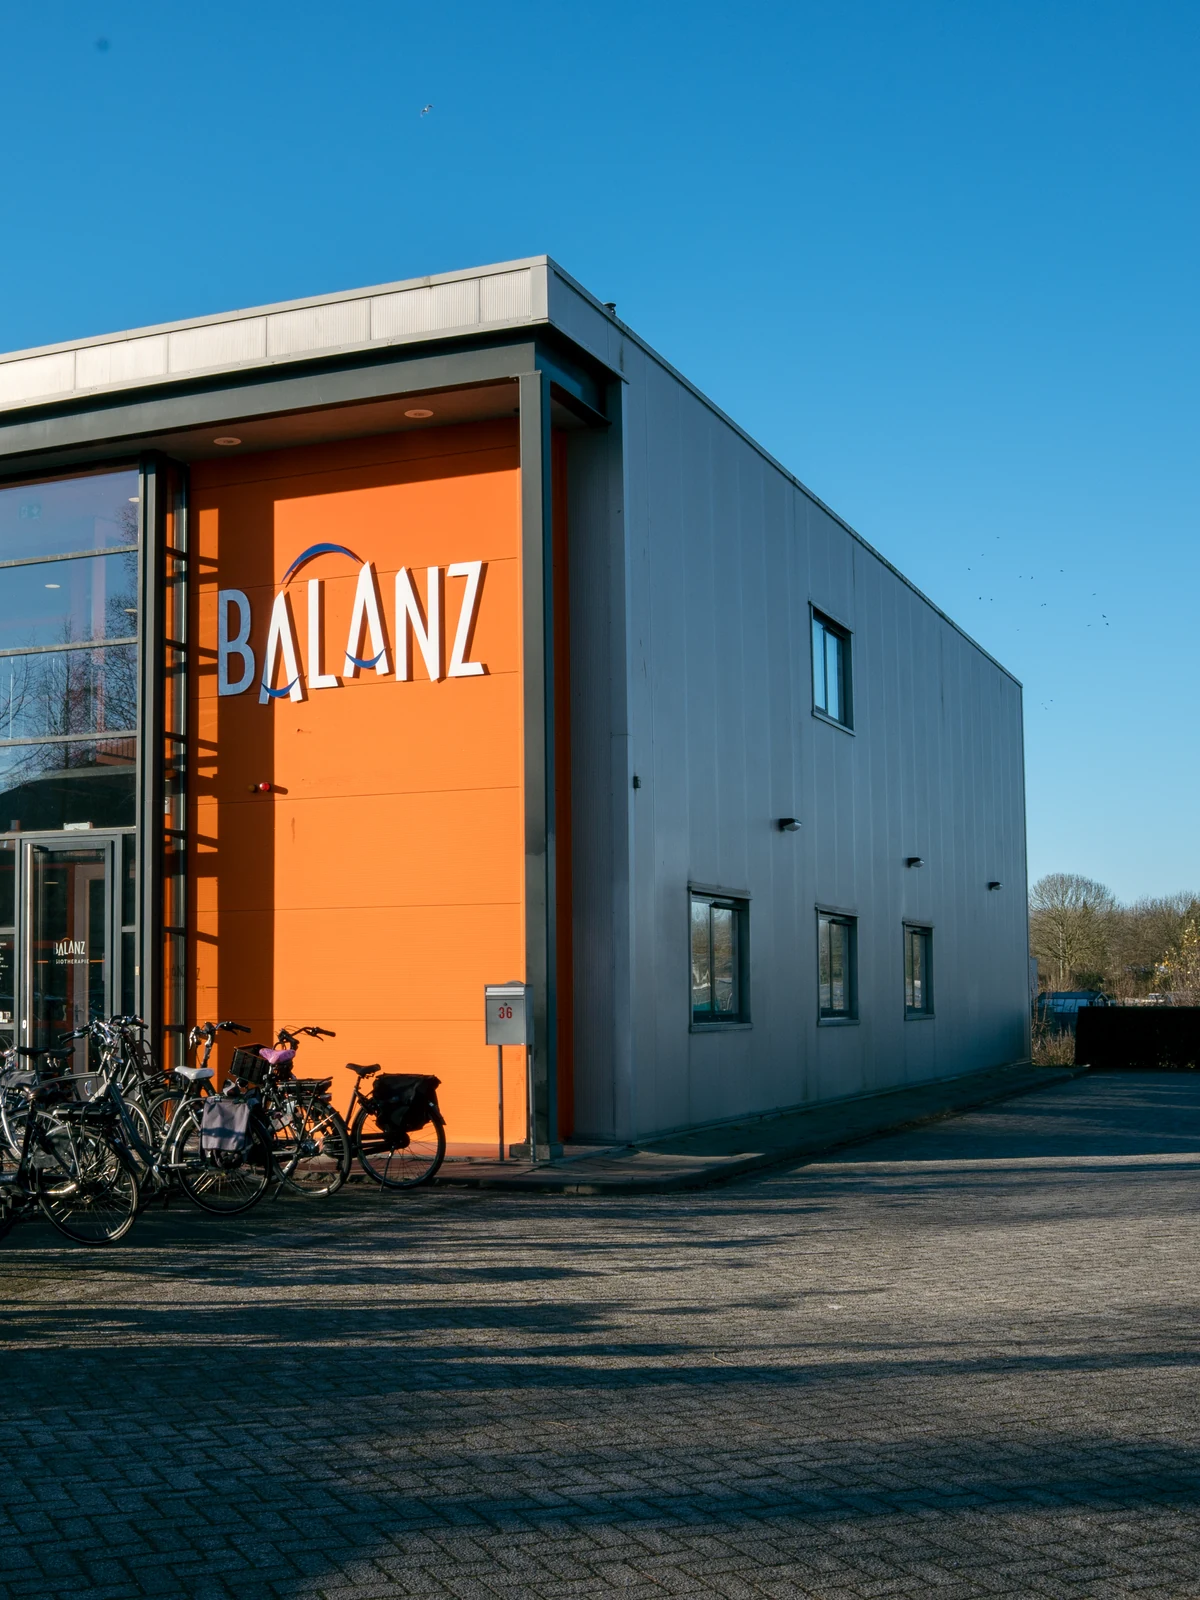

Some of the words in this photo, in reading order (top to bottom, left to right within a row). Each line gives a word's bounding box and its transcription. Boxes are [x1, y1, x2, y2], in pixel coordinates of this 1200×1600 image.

[218, 560, 485, 705] BALANZ
[53, 940, 86, 956] BALANZ
[498, 1006, 513, 1019] 36
